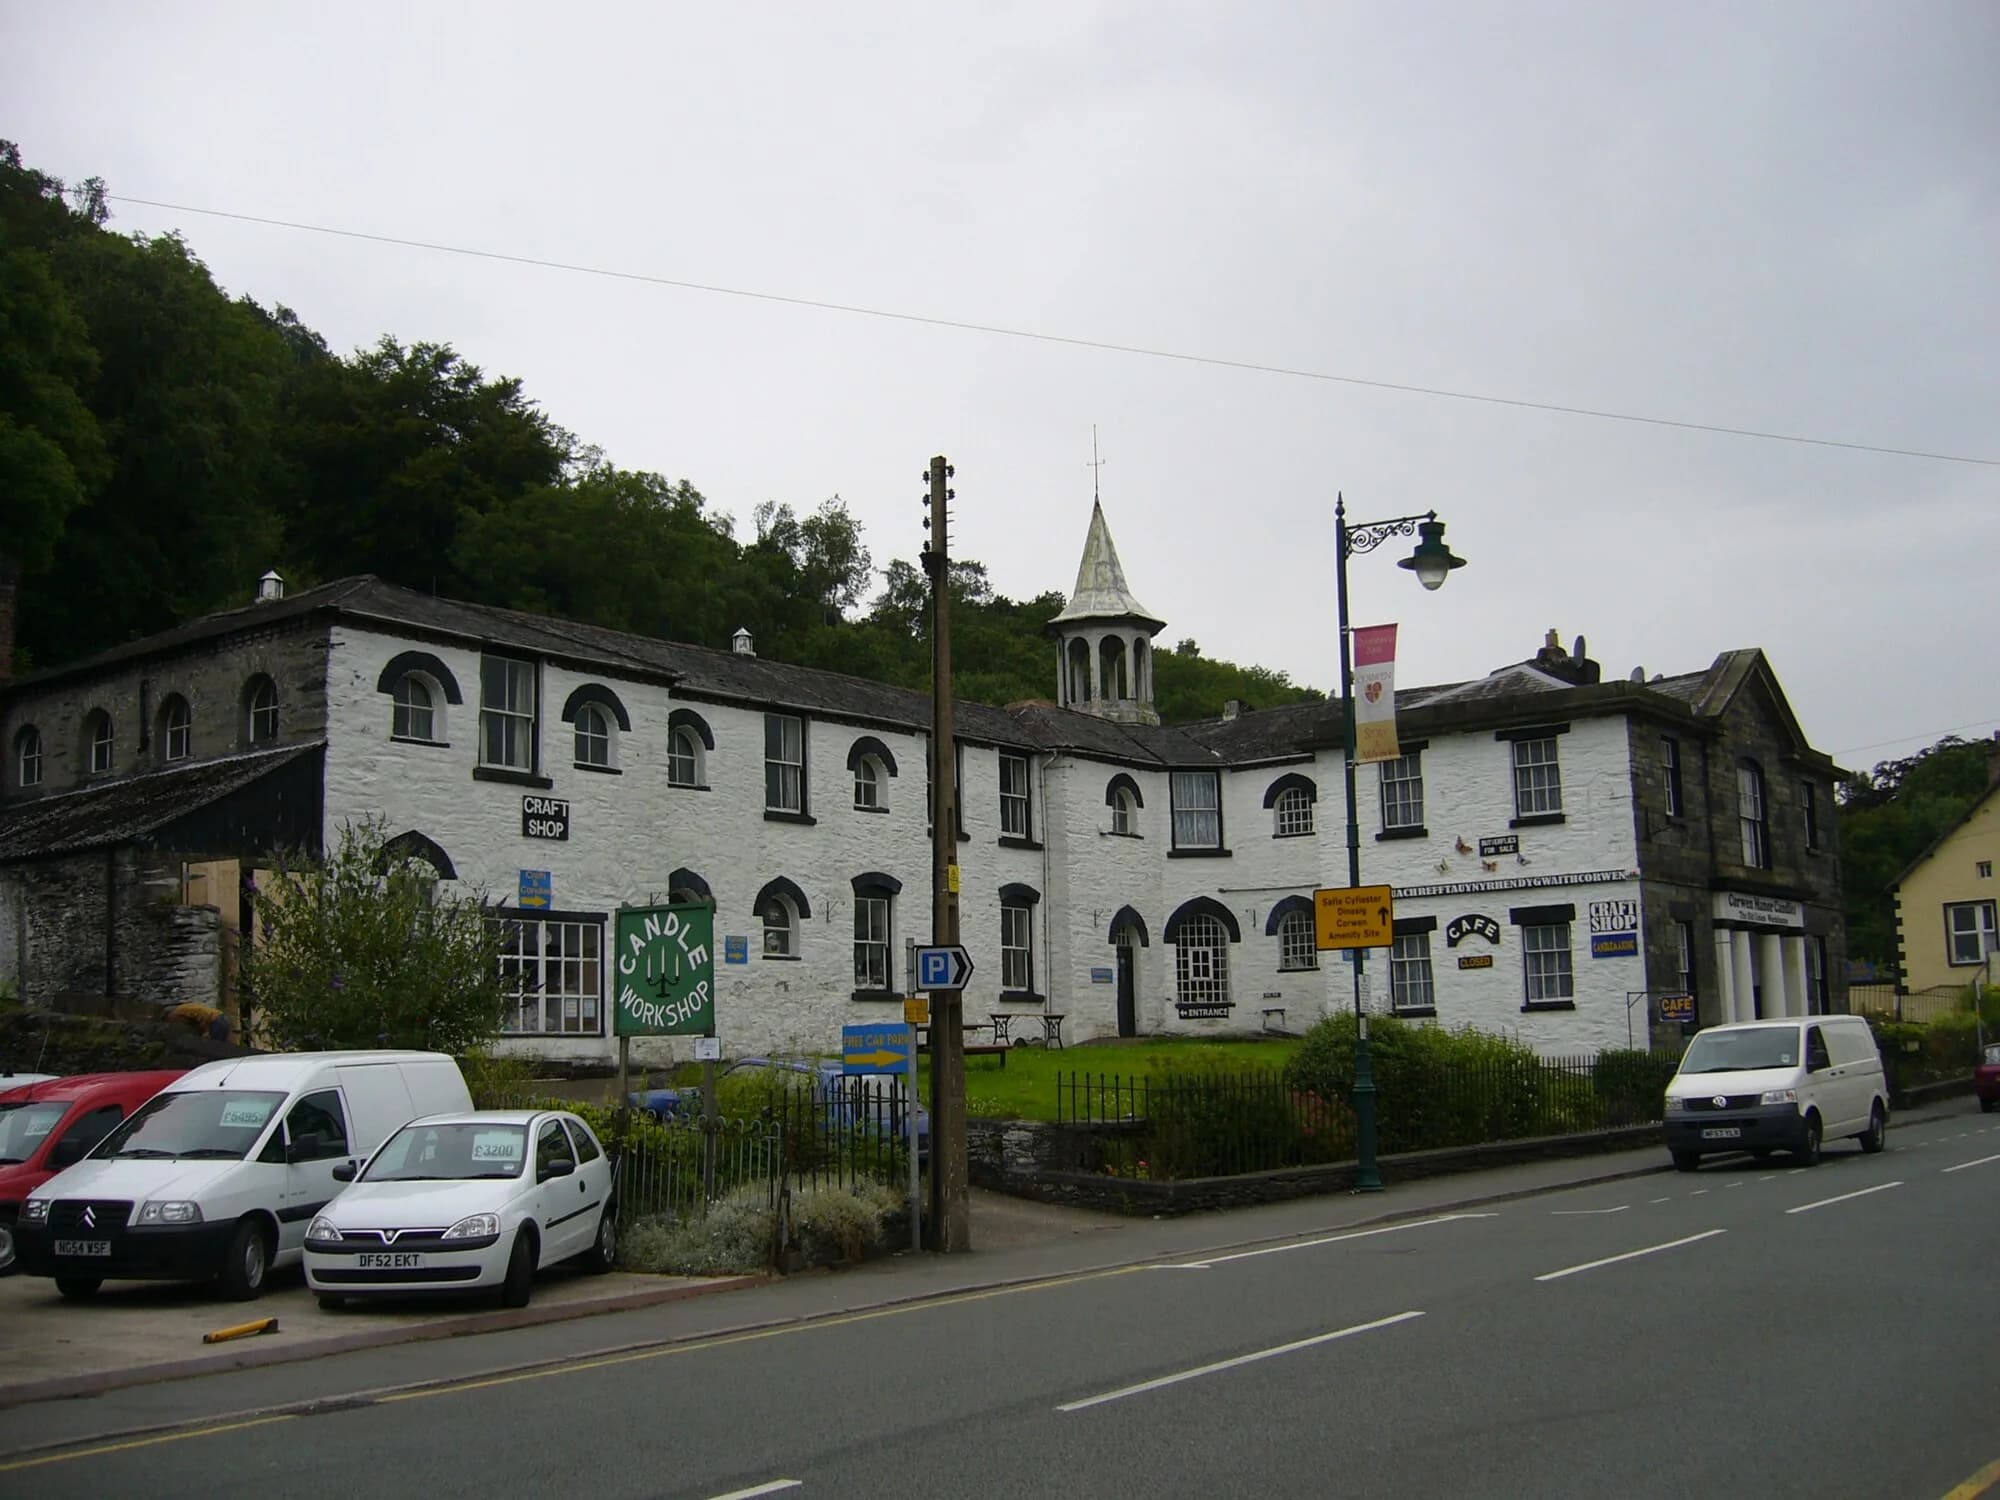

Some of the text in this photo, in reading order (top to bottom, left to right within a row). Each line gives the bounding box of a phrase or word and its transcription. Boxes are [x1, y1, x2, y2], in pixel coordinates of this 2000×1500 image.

[524, 797, 569, 817] CRAFT
[528, 819, 564, 837] SHOP
[1590, 901, 1636, 917] CRAFT
[1336, 919, 1367, 927] Corwen
[1449, 918, 1497, 938] CAFE
[1591, 915, 1637, 932] SHOP
[1328, 929, 1380, 940] Amenity Site
[619, 912, 709, 975] CANDLE
[928, 956, 945, 981] P
[1461, 957, 1490, 967] CLOSED
[619, 980, 709, 1027] WORKSHOP
[1662, 999, 1692, 1011] CAFE
[1188, 1008, 1229, 1017] ENTRANCE
[474, 1145, 513, 1157] £3200
[360, 1254, 420, 1267] DF52 EKT
